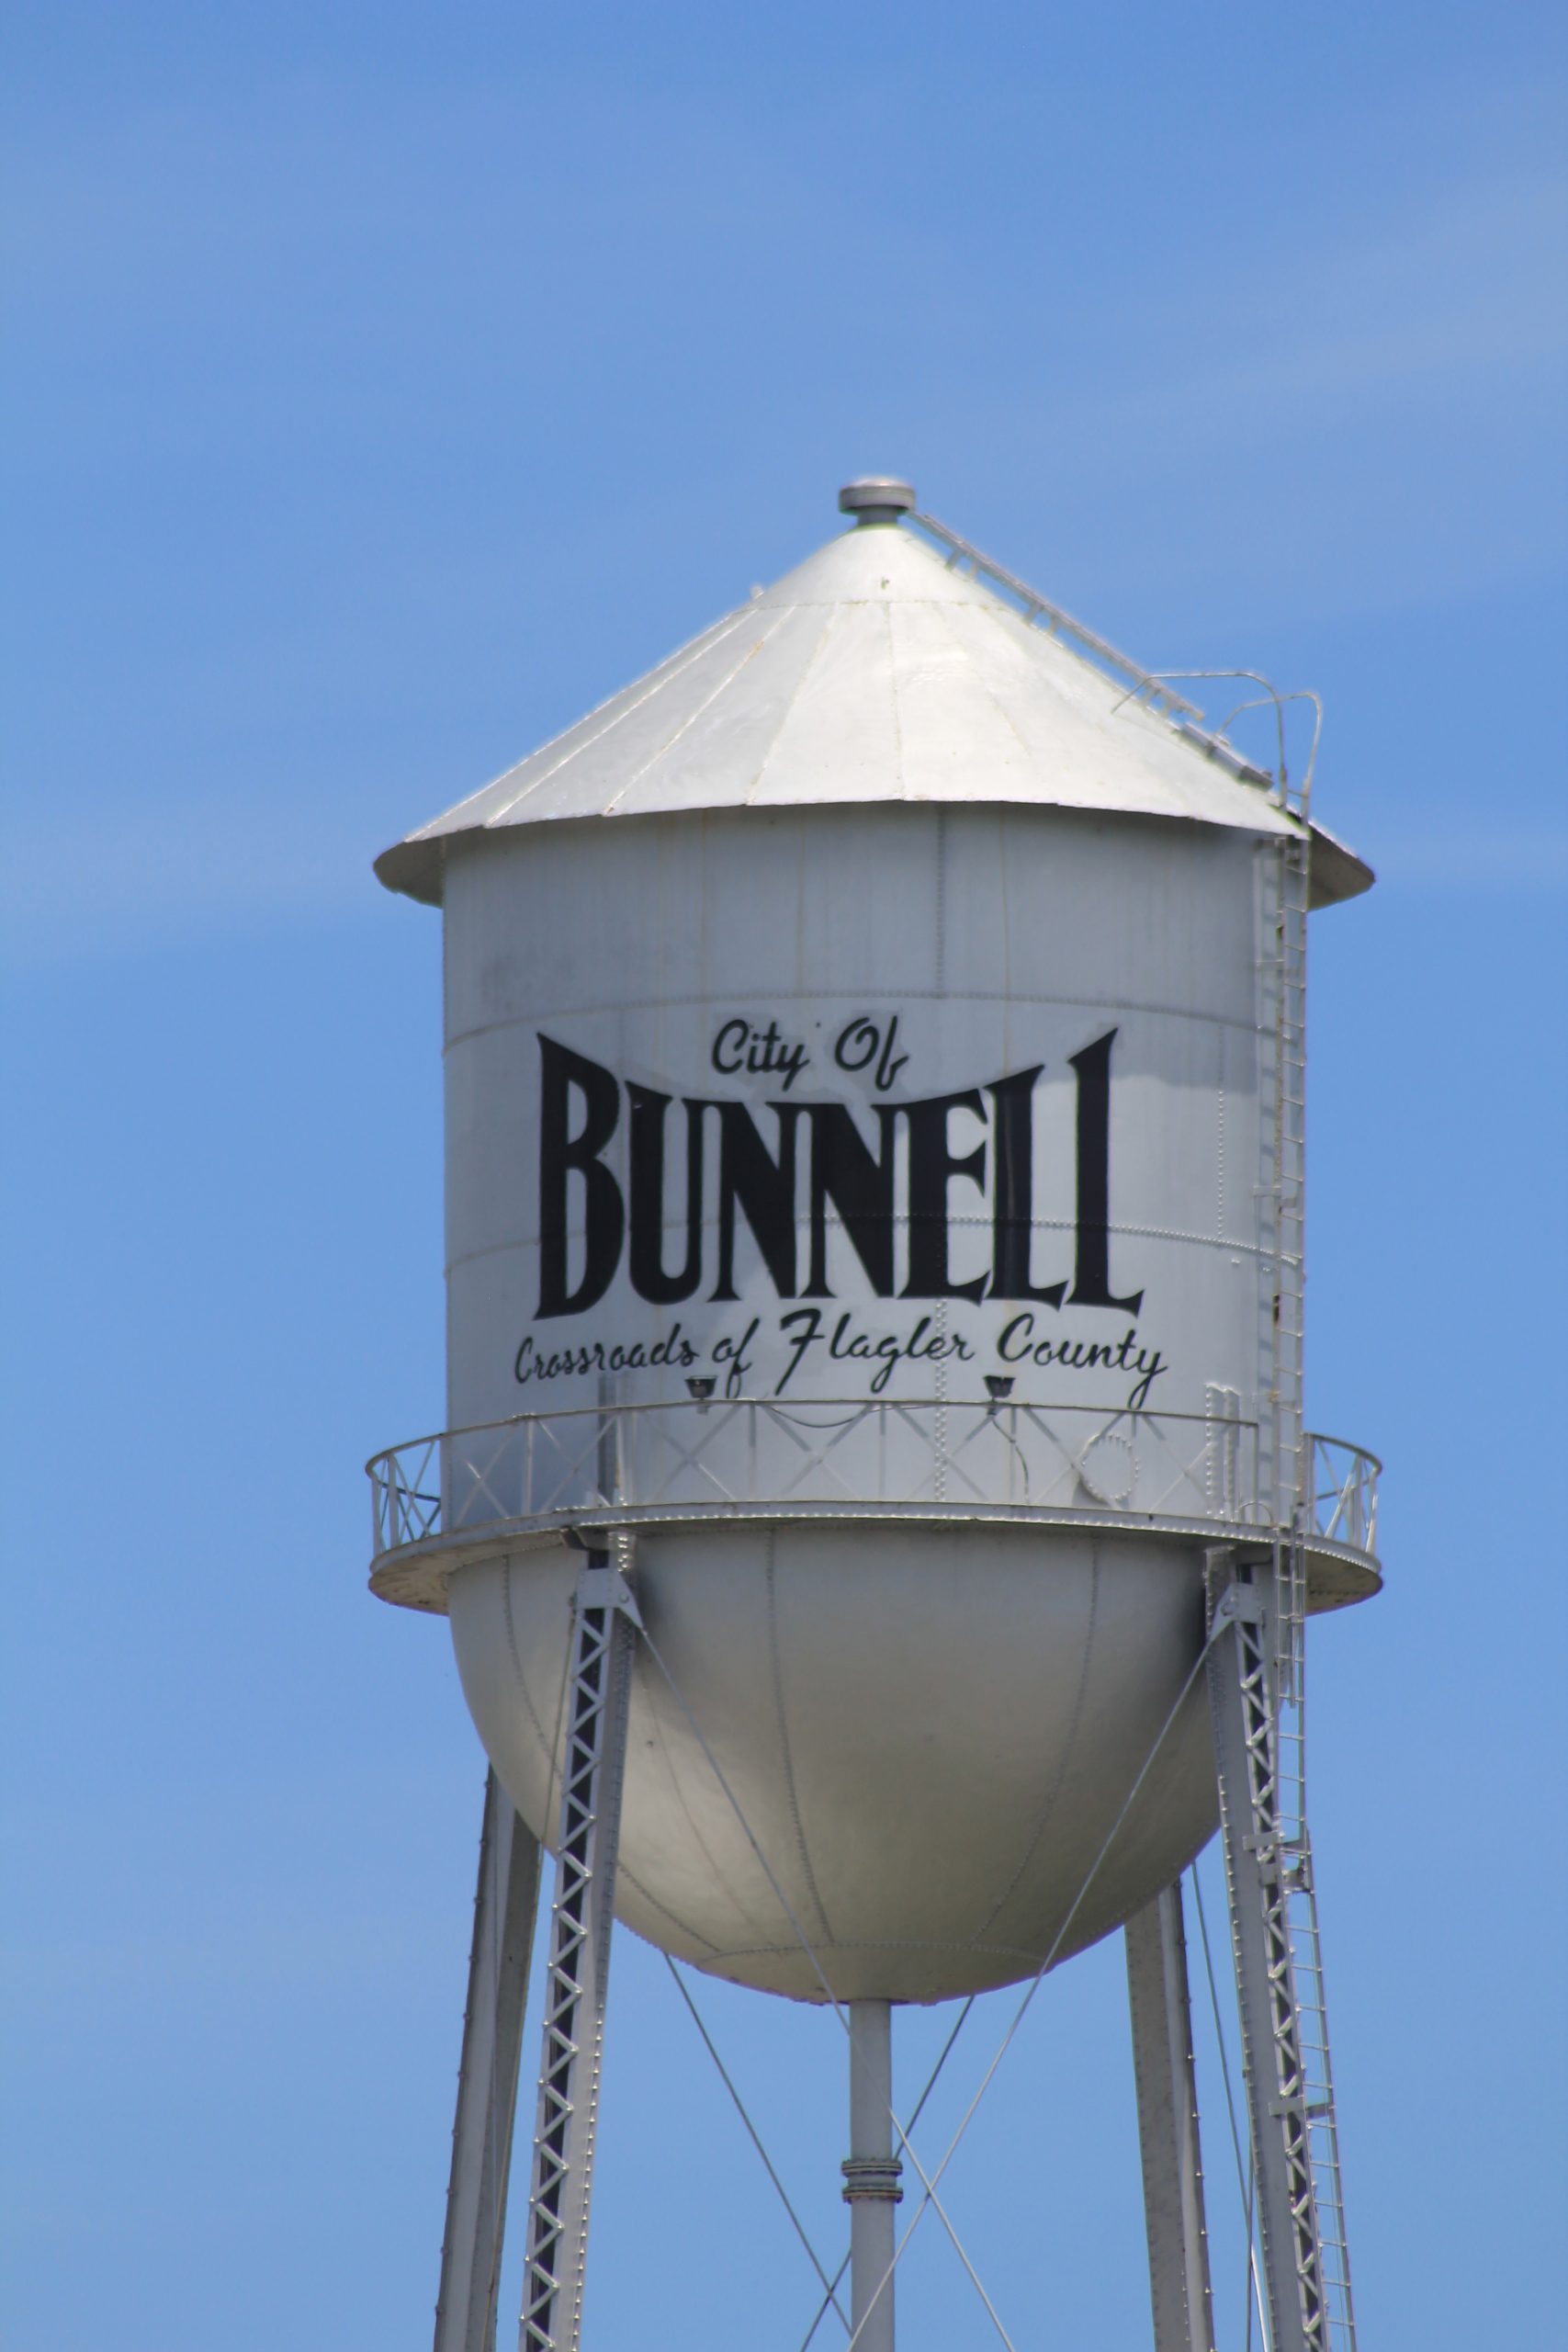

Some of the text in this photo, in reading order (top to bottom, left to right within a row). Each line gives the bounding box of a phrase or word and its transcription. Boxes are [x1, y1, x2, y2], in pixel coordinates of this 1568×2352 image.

[711, 1015, 909, 1091] City Of
[532, 1027, 1145, 1321] BUNNELL
[514, 1308, 1168, 1410] Crossroads of Flagler County
